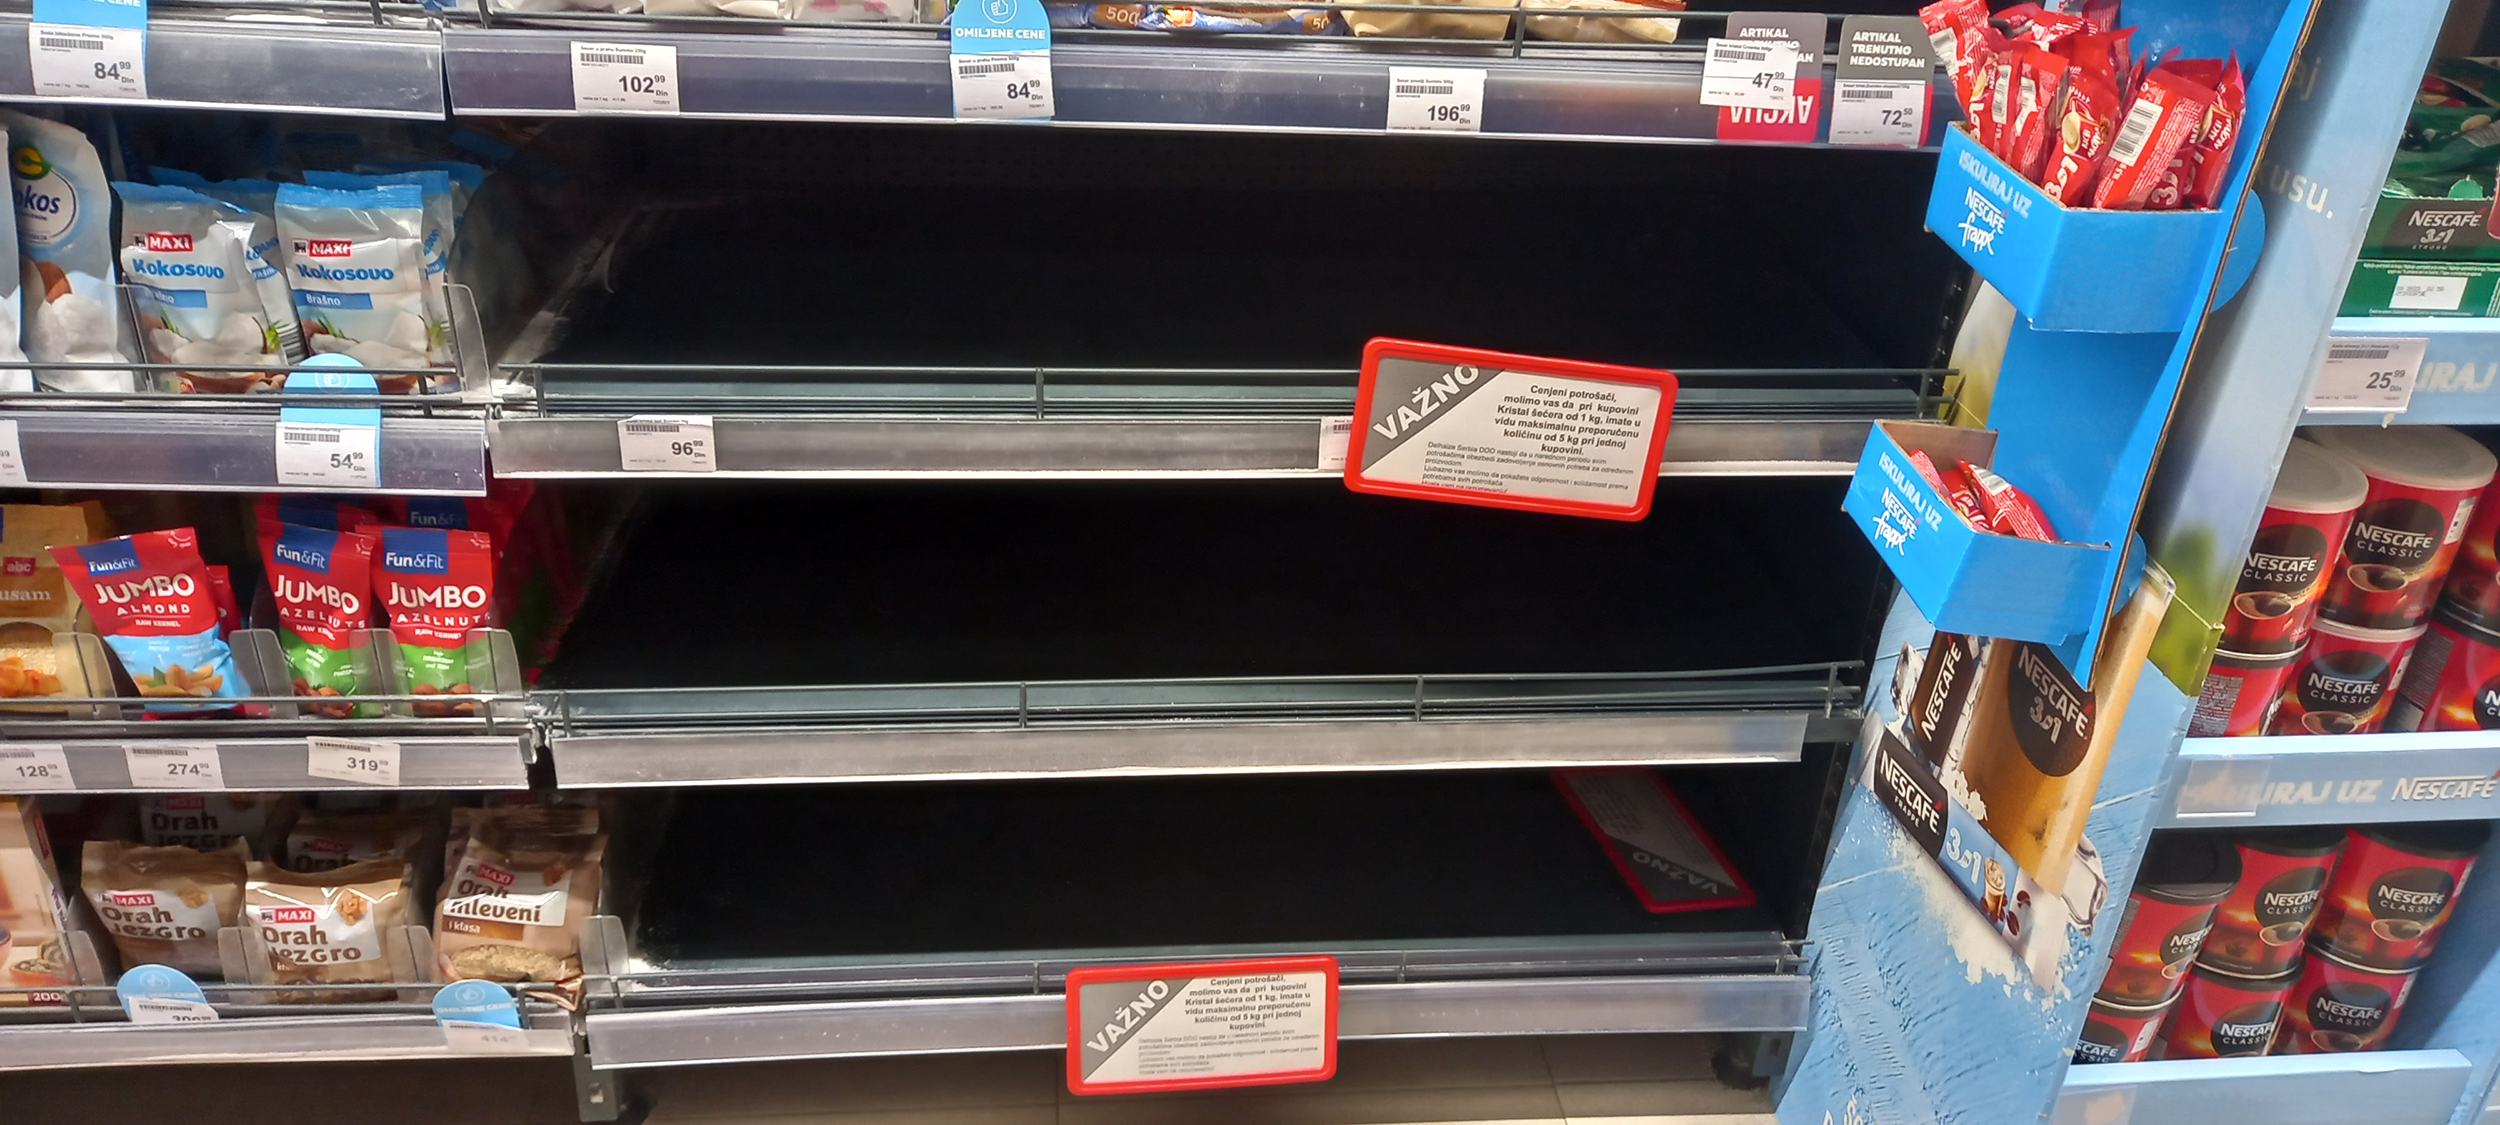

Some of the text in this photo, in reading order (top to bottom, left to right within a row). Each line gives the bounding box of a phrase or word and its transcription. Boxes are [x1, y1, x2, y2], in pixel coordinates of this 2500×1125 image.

[955, 28, 1046, 40] OMILJENE CENE
[1739, 28, 1789, 38] ARTIKAL
[1852, 31, 1902, 43] ARTIKAL
[1852, 44, 1912, 55] TRENUTNO
[1850, 56, 1925, 68] NEDOSTUPAN
[94, 61, 132, 80] 84 99
[618, 74, 666, 94] 102 99
[1752, 71, 1785, 89] 47 99
[1007, 80, 1041, 100] 84 99
[1428, 104, 1471, 122] 196 99
[1882, 108, 1913, 126] 72 50
[1958, 149, 2033, 219] ISKULIRAJ UZ
[150, 238, 190, 250] MAXI
[312, 244, 350, 255] MAXI
[2366, 370, 2406, 390] 25 99
[1372, 362, 1479, 440] VAŽNO
[1530, 384, 1618, 403] Cenjeni potrošači,
[1504, 396, 1540, 406] molimo
[1562, 399, 1574, 409] da
[1578, 402, 1593, 412] pri
[1597, 404, 1639, 416] kupovini
[1496, 404, 1530, 416] Kristal
[1532, 408, 1563, 420] šećera
[1565, 412, 1578, 421] od
[1580, 414, 1586, 422] 1
[1606, 416, 1632, 427] imate
[1494, 416, 1640, 438] vidu maksimalnu preporučenu
[1428, 442, 1456, 450] Delhaize
[1504, 428, 1627, 450] količinu od 5 kg pri jednoj
[671, 441, 694, 456] 96
[1541, 443, 1584, 456] kupovini.
[330, 452, 364, 469] 54 99
[1424, 465, 1453, 474] Ljubazno
[1878, 451, 1943, 532] ISKULIRAJ UZ
[276, 544, 326, 569] Fun&Fit
[2356, 540, 2423, 559] CLASSIC
[88, 558, 136, 572] Fun&Fit
[386, 552, 444, 570] Fun&Fit
[2243, 568, 2308, 582] CLASSIC
[94, 573, 195, 604] JUMBO
[274, 574, 360, 615] JUMBO
[388, 582, 487, 608] JUMBO
[117, 603, 190, 616] ALMOND
[153, 620, 181, 628] KERNEL
[2310, 690, 2372, 704] CLASSIC
[16, 766, 50, 778] 128
[167, 763, 200, 776] 274
[346, 757, 378, 772] 319
[2336, 779, 2383, 804] UZ
[151, 810, 220, 831] Orah
[480, 866, 512, 884] MAXI
[457, 880, 509, 899] Orah
[114, 894, 154, 906] MAXI
[2380, 900, 2436, 913] CLASSIC
[101, 906, 174, 924] Orah
[278, 910, 312, 921] MAXI
[262, 924, 328, 946] Orah
[454, 922, 481, 934] klasa
[1189, 988, 1221, 996] molimo
[1254, 985, 1266, 993] pri
[1270, 982, 1307, 992] kupovini
[1210, 976, 1242, 986] Cenjeni
[1184, 1007, 1204, 1015] vidu
[1205, 1004, 1256, 1014] maksimalnu
[1185, 998, 1214, 1006] Kristal
[1086, 980, 1170, 1053] VAŽNO
[1250, 1012, 1260, 1021] kg
[1262, 1012, 1274, 1020] pri
[2318, 1012, 2374, 1028] CLASSIC
